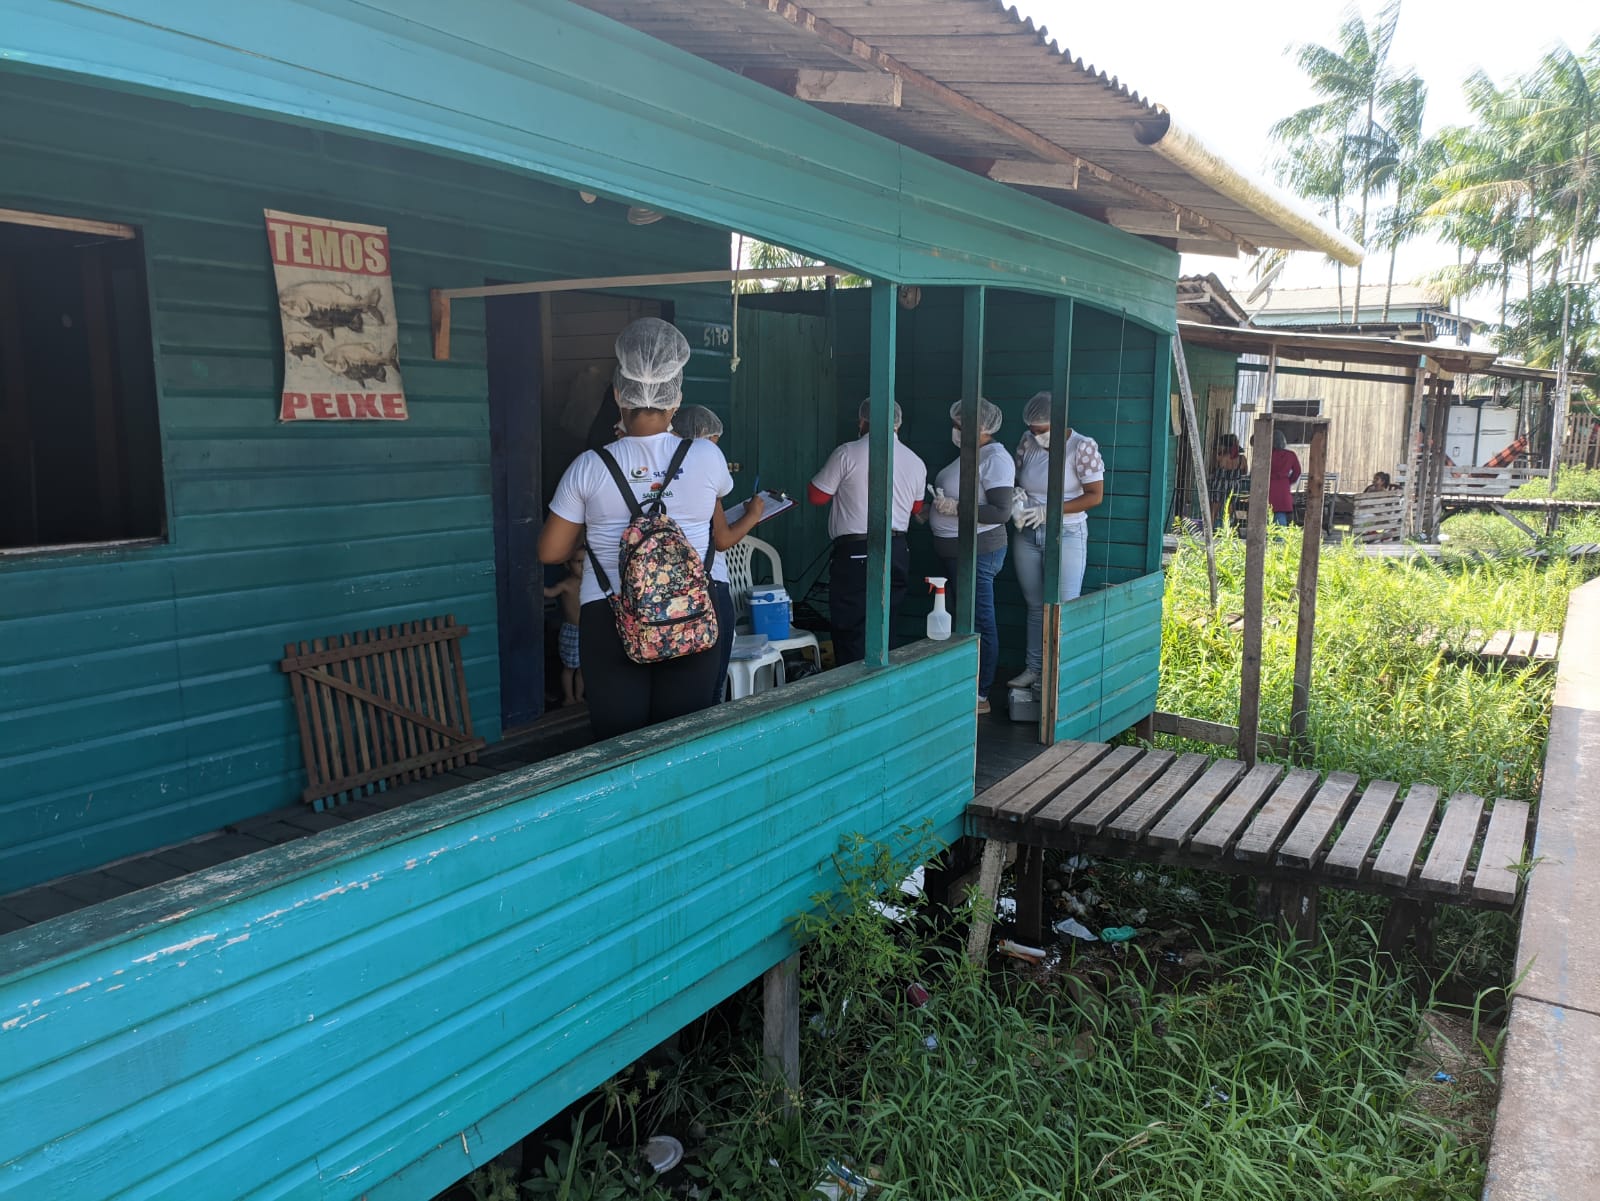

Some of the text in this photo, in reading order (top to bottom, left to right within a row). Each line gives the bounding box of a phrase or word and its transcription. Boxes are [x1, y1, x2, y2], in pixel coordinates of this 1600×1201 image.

[269, 222, 387, 273] TEMOS
[282, 391, 406, 420] PEIXE
[642, 490, 674, 499] SANTNA
